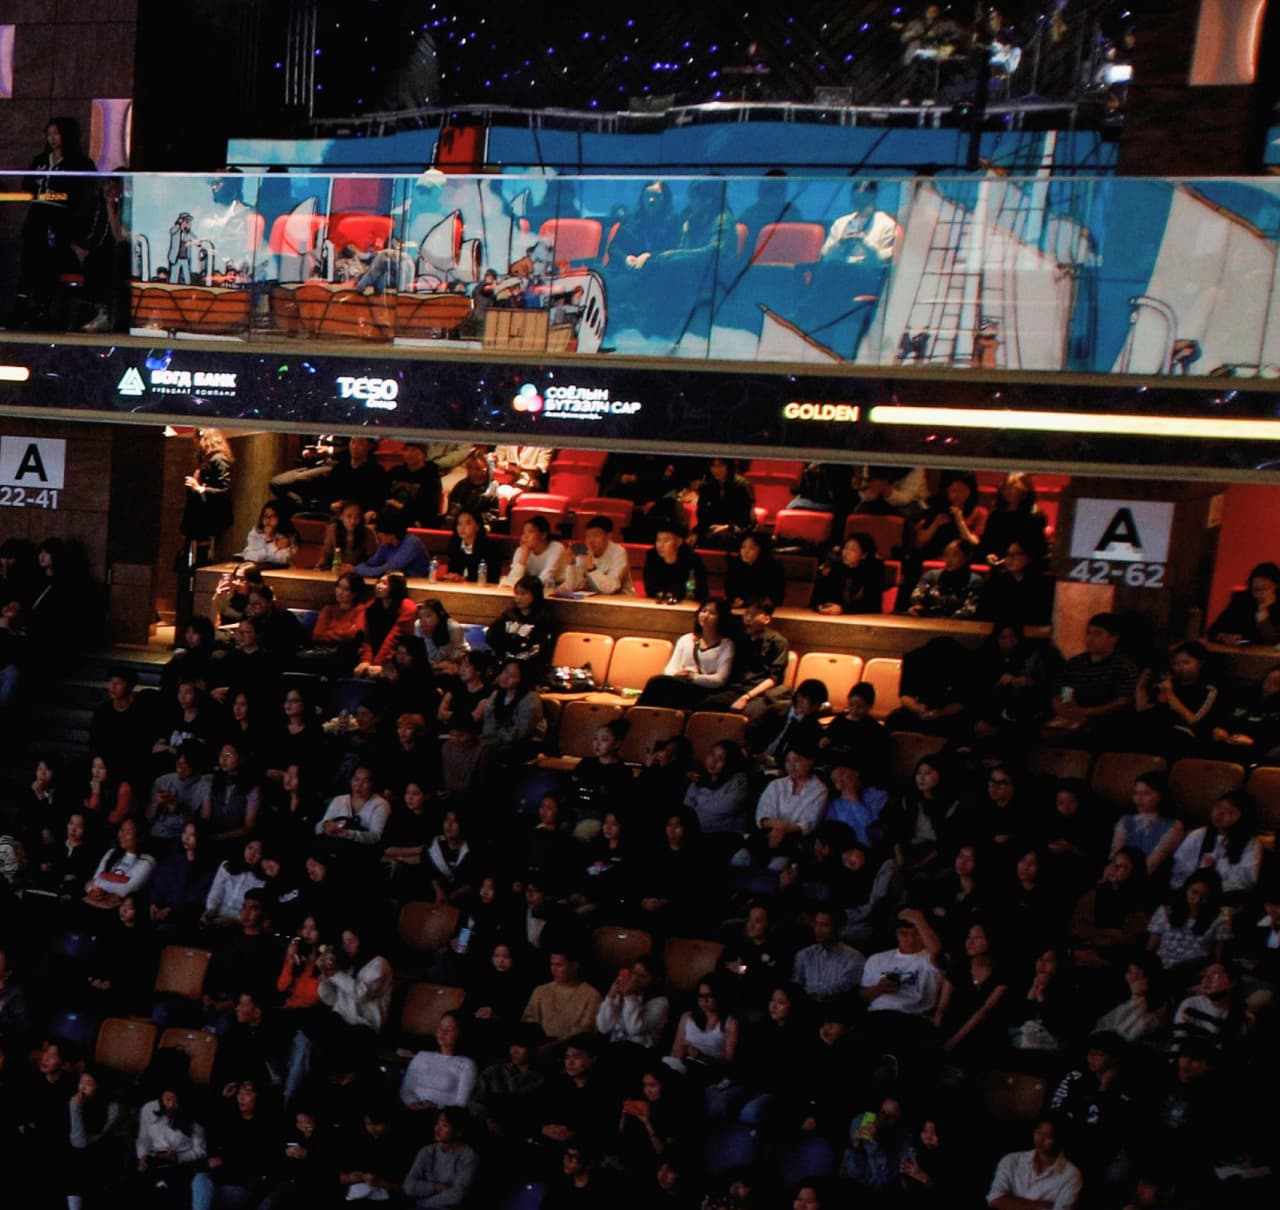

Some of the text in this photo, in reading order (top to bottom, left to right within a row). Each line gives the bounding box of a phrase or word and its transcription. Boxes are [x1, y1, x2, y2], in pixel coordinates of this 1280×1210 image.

[337, 376, 398, 399] TESO
[610, 401, 641, 414] САР
[784, 402, 859, 421] GOLDEN
[14, 443, 48, 482] A
[0, 486, 58, 509] 22-41
[1094, 507, 1143, 554] A
[1069, 560, 1164, 588] 42-62
